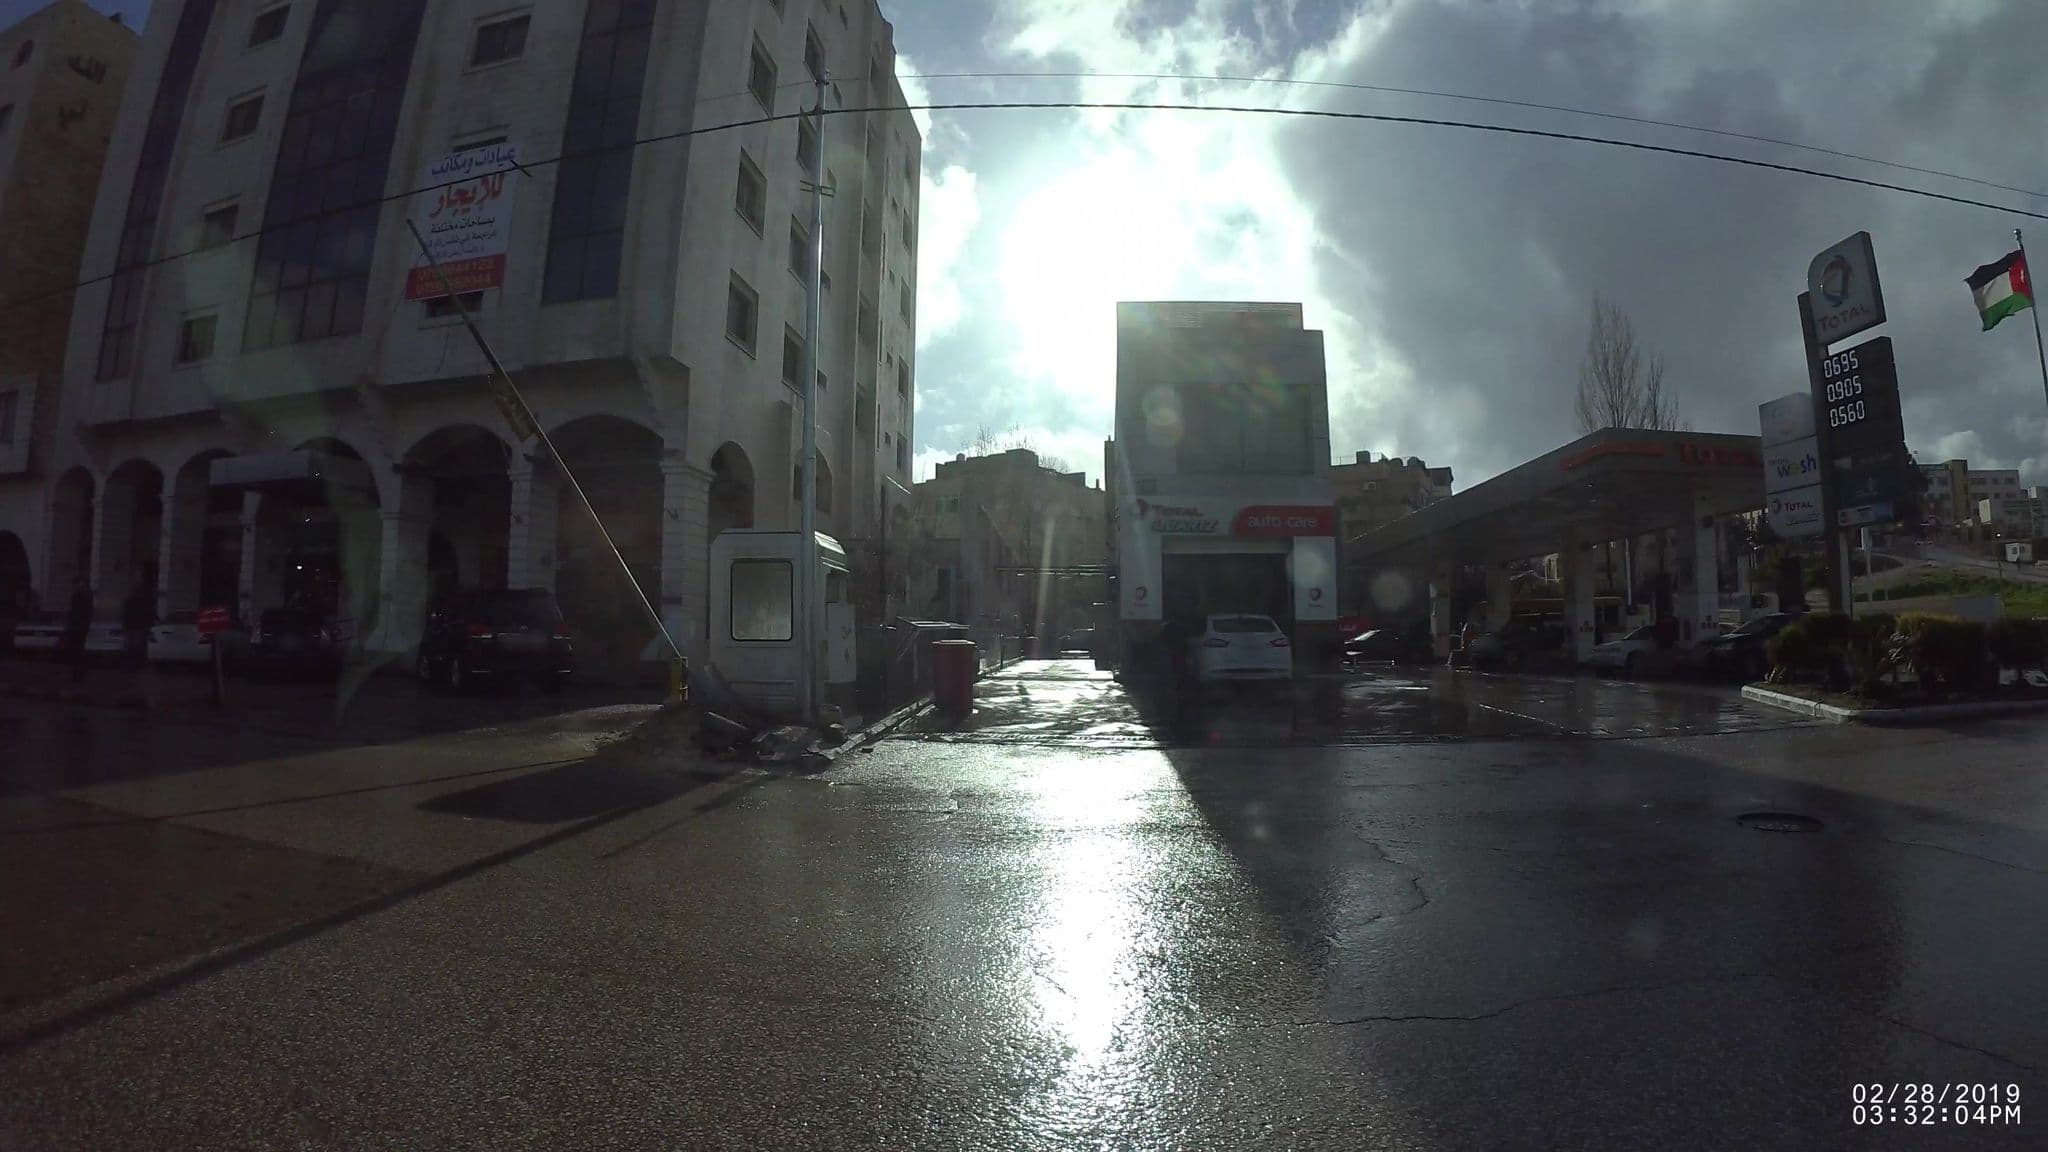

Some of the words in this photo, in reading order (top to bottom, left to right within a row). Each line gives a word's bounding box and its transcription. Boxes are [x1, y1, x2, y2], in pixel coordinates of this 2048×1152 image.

[432, 153, 474, 176] ومكاتب
[475, 146, 516, 167] عيادات
[1816, 302, 1871, 330] TOTAL
[1823, 350, 1859, 378] 0695
[1826, 375, 1862, 402] 0905
[1830, 400, 1865, 427] 0560
[1784, 500, 1813, 512] TOTAL
[1247, 513, 1281, 528] auto
[1287, 515, 1318, 528] care
